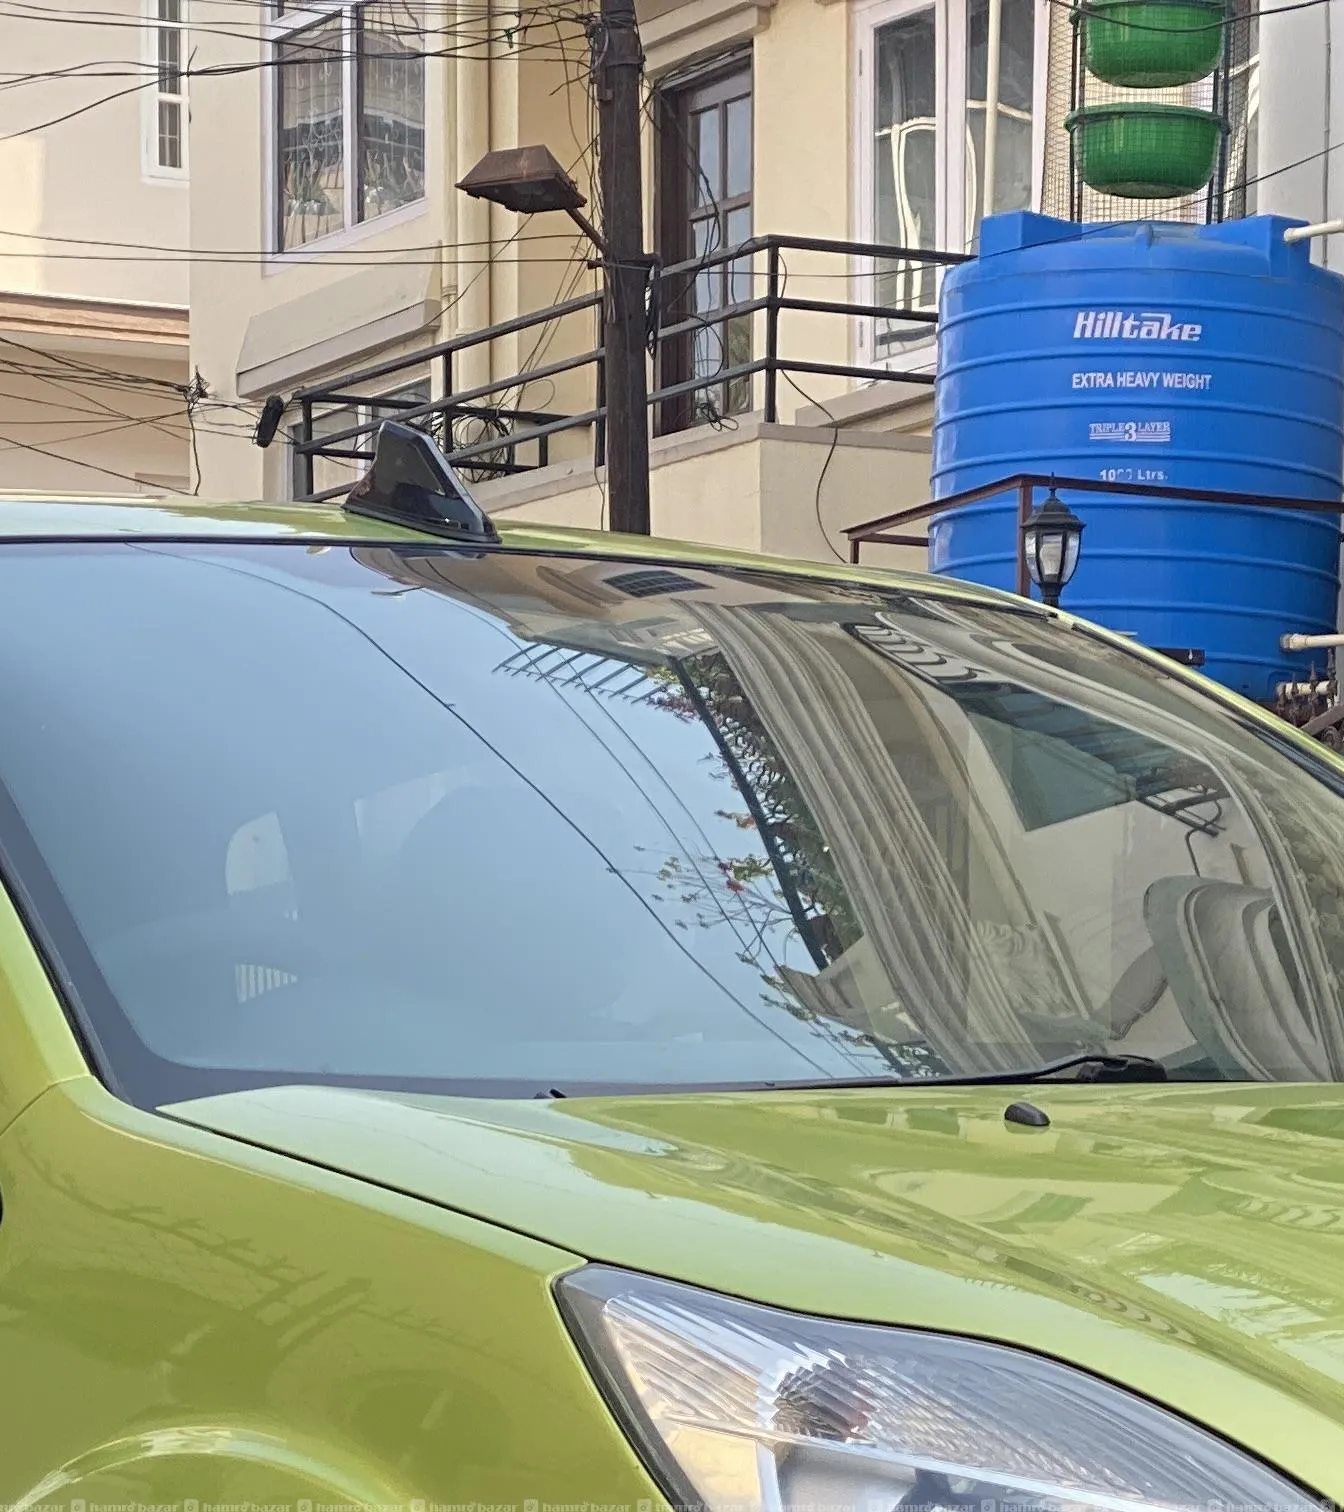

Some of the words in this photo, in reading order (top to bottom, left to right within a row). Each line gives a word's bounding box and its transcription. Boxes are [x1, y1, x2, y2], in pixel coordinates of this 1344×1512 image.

[1073, 311, 1203, 341] Hilltake
[1072, 372, 1114, 389] EXTRA
[1117, 371, 1160, 388] HEAVY
[1162, 372, 1212, 390] WEIGHT
[1089, 422, 1125, 433] TRIPLE
[1124, 421, 1137, 442] 3
[1138, 421, 1171, 433] LAYER
